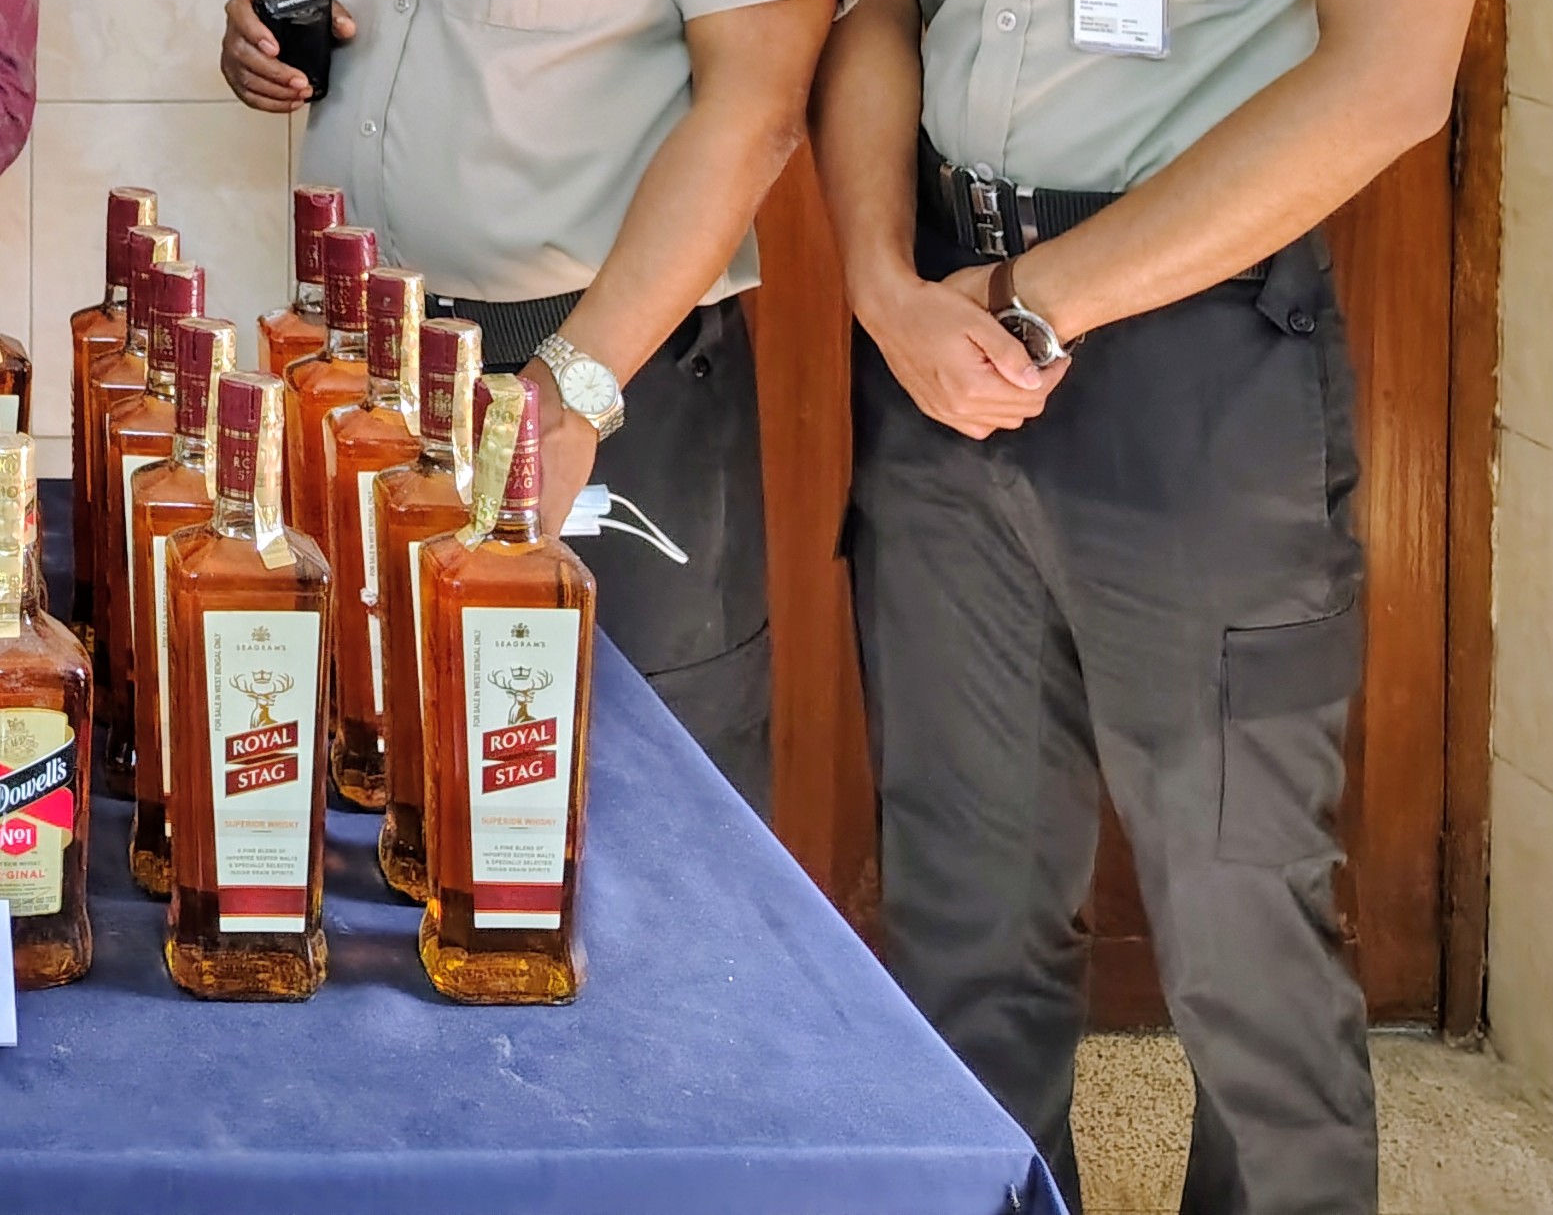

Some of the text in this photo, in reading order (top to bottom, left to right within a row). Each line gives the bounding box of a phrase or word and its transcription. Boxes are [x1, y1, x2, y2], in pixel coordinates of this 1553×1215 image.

[232, 727, 292, 756] ROYAL
[490, 723, 551, 752] ROYAL
[237, 764, 286, 789] STAG
[495, 760, 543, 786] STAG
